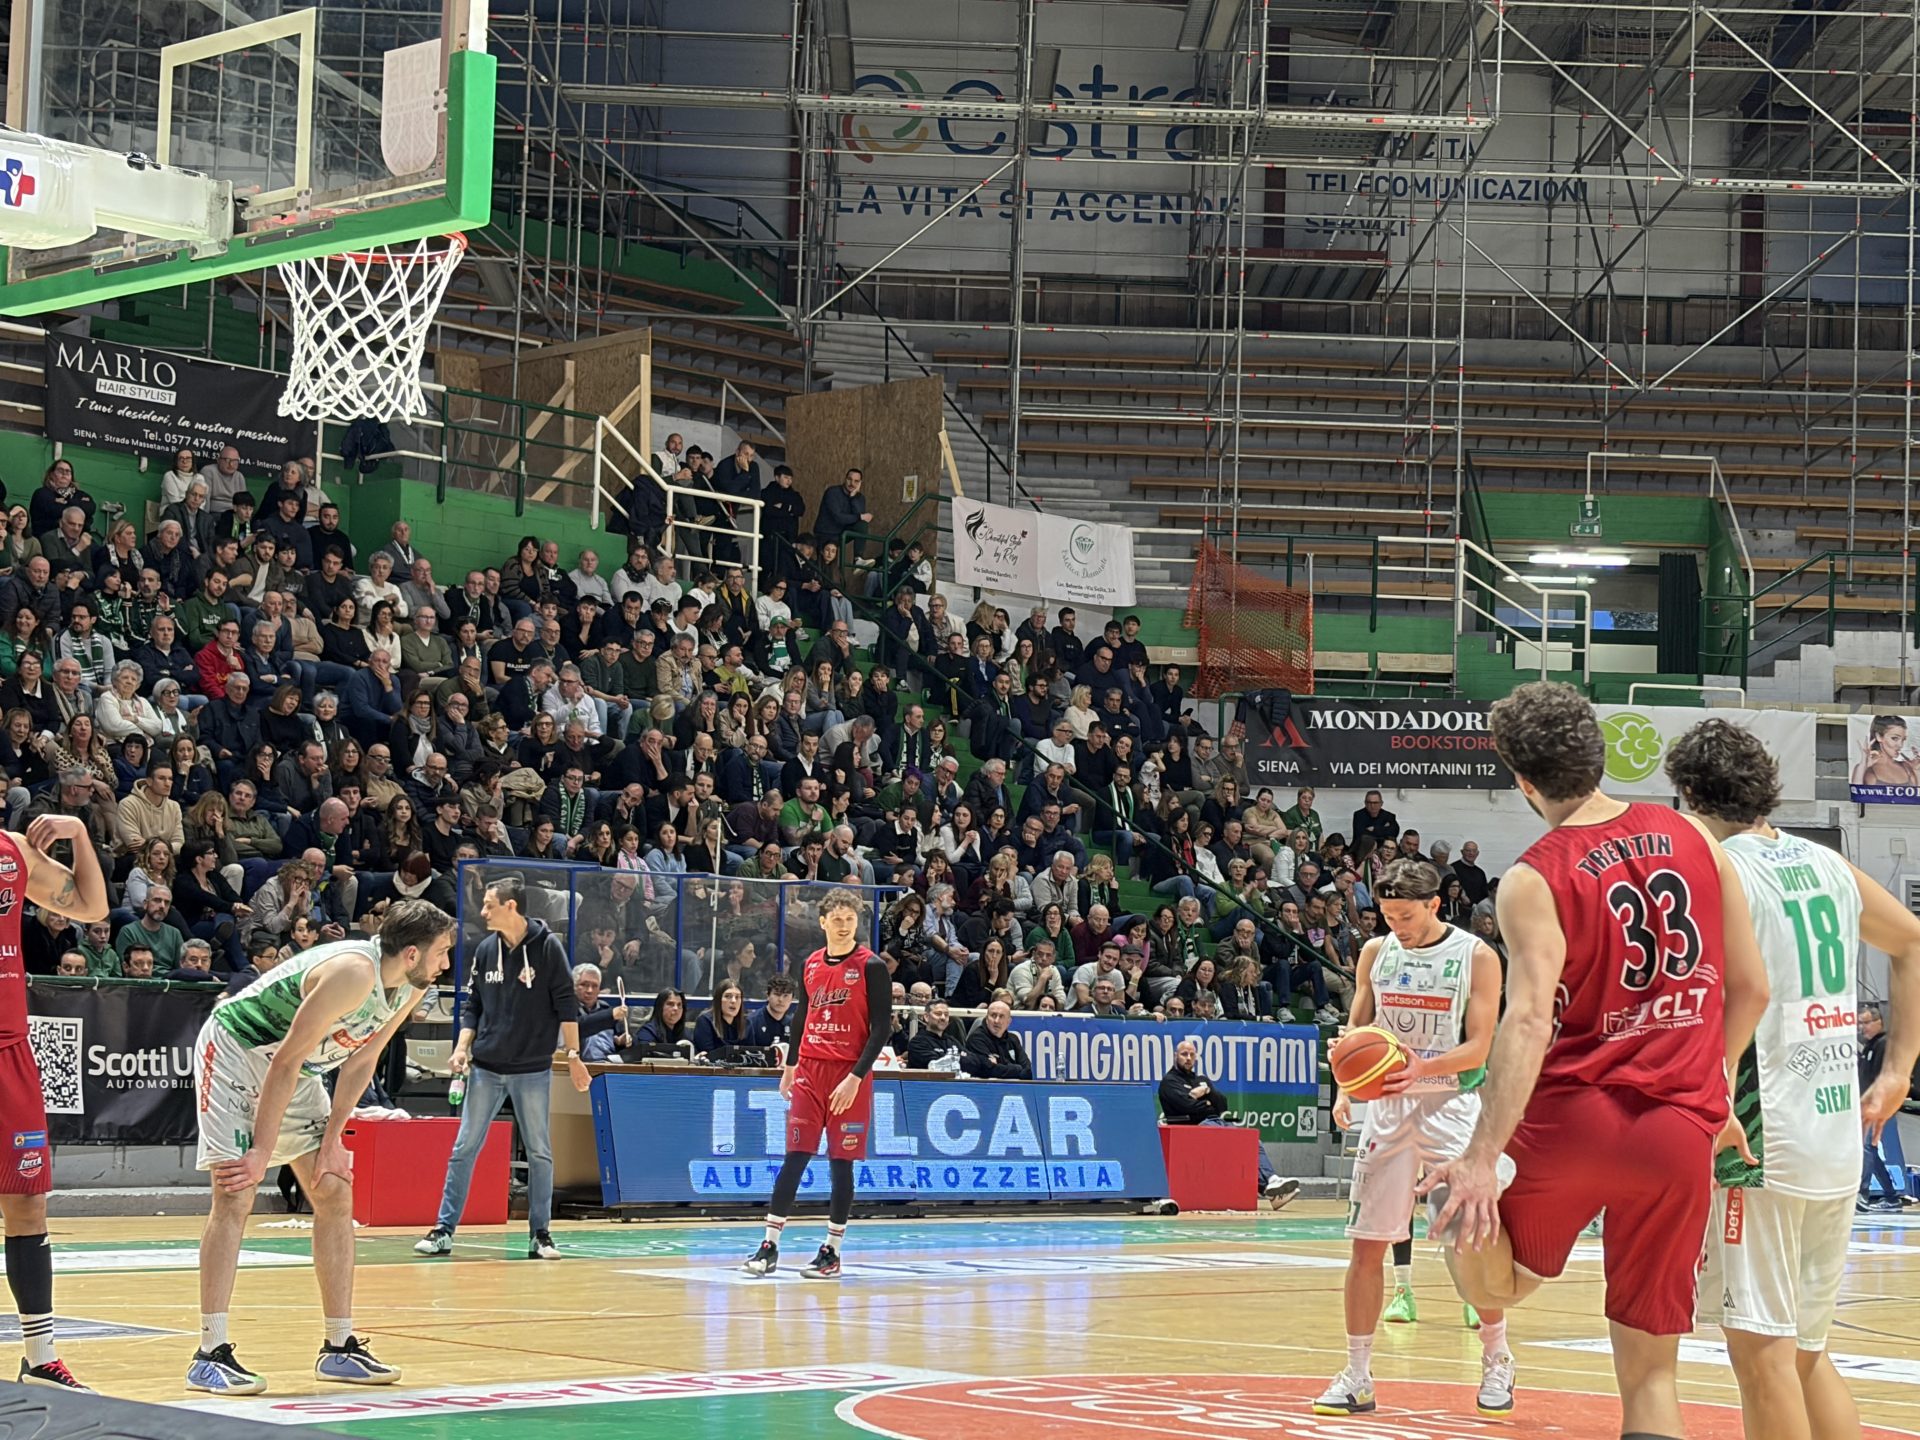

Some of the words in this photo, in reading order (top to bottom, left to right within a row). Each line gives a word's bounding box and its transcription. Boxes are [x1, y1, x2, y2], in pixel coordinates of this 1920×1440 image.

[898, 186, 983, 218] VITA
[56, 342, 176, 388] MARIO
[99, 381, 126, 395] HAIR
[129, 386, 174, 403] STYLIST
[75, 397, 87, 409] I
[89, 400, 113, 414] tuoi
[117, 405, 173, 428] desideri,
[178, 415, 192, 428] la
[194, 421, 233, 435] nostra
[236, 427, 289, 445] passione
[143, 428, 162, 442] Tel.
[165, 432, 191, 446] 0577
[73, 428, 97, 440] SIENA
[104, 433, 130, 446] Strada
[131, 437, 170, 453] Massetana
[1257, 760, 1300, 774] SIENA
[1330, 762, 1354, 775] VIA
[1358, 762, 1381, 775] DEI
[1386, 762, 1471, 776] MONTANINI
[1475, 763, 1496, 776] 112
[1575, 832, 1673, 880] TRENTIN
[1606, 868, 1703, 991] 33
[1782, 894, 1847, 998] 18
[1443, 959, 1462, 978] 27
[1652, 988, 1708, 1020] CLT
[1381, 1010, 1446, 1036] NOTE
[88, 1045, 168, 1077] Scotti
[1010, 1029, 1173, 1081] IANIGIANI
[106, 1079, 194, 1090] AUTOMOBILI
[712, 1089, 1097, 1158] ITLCAR
[703, 1165, 1112, 1189] AUTOARROZZERIA
